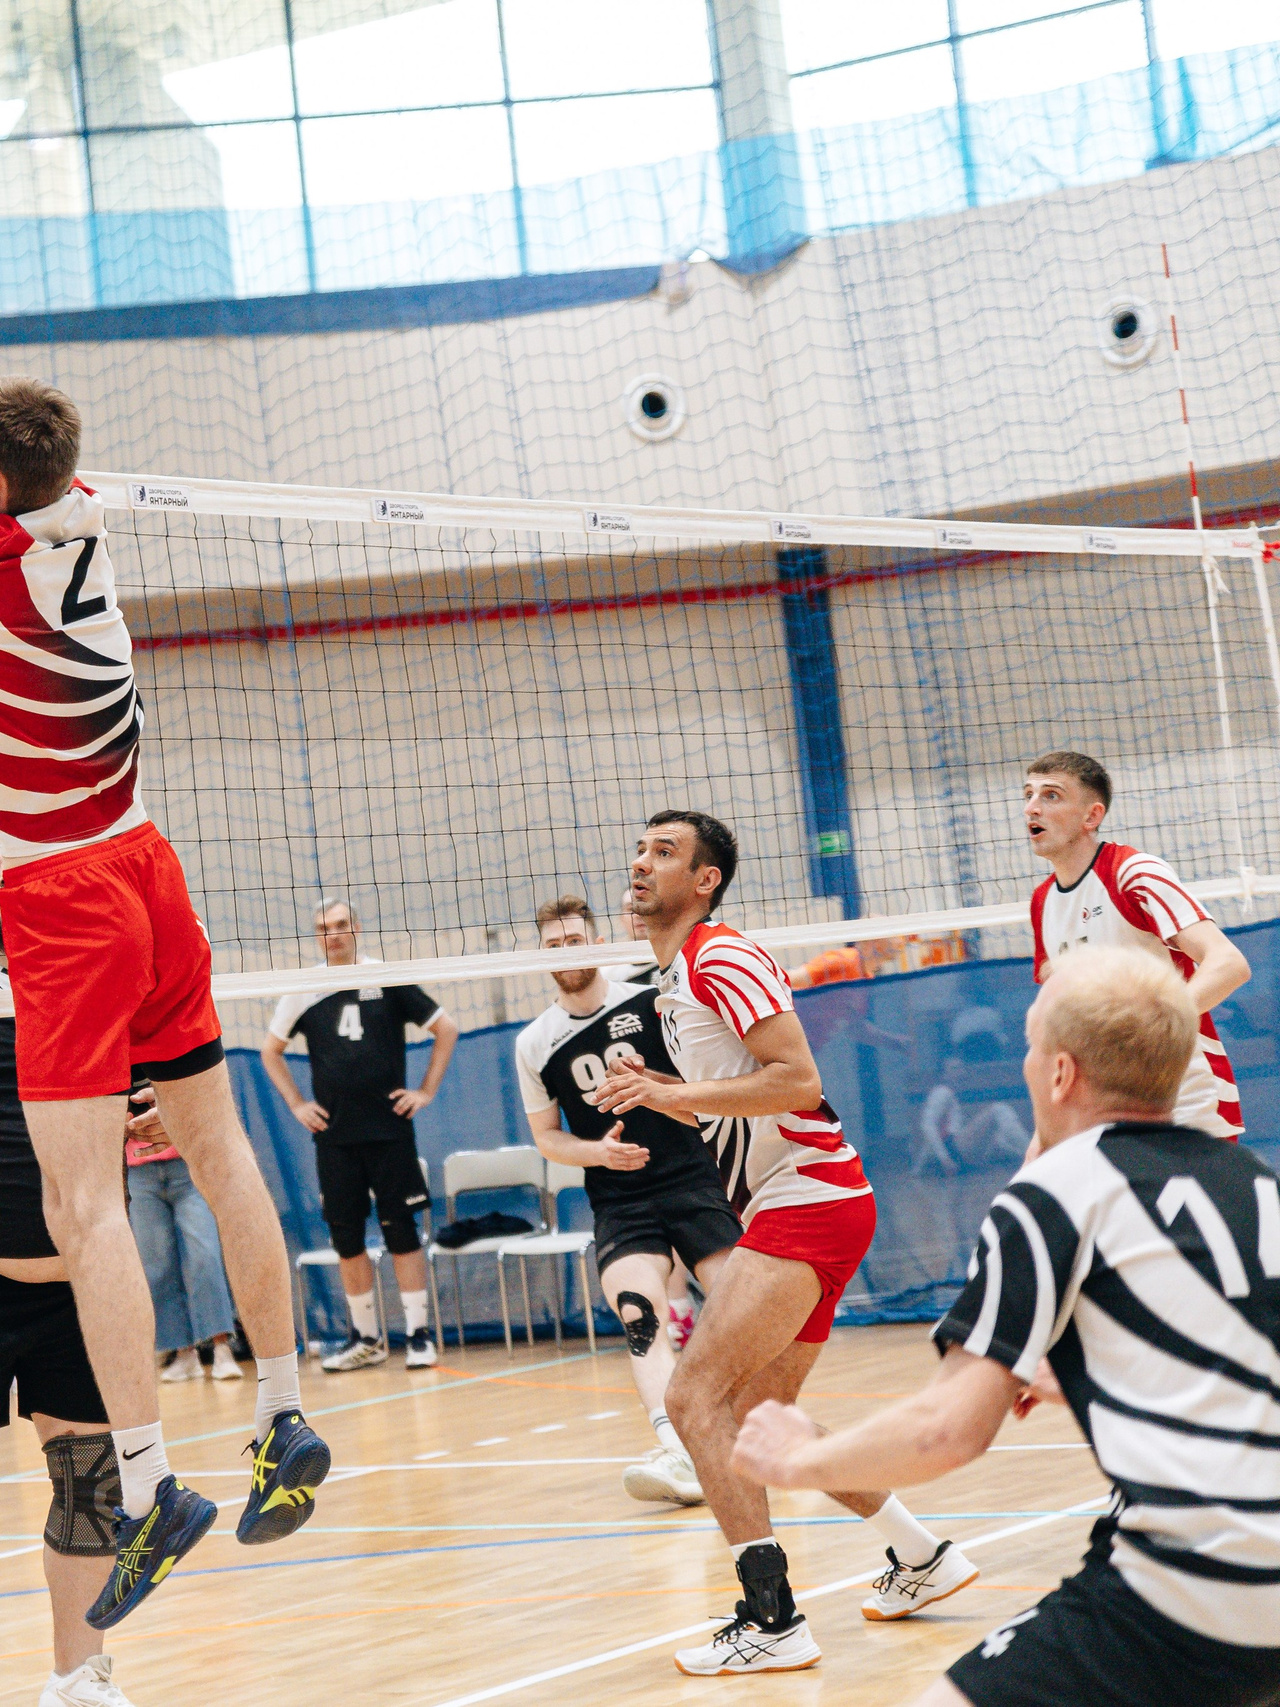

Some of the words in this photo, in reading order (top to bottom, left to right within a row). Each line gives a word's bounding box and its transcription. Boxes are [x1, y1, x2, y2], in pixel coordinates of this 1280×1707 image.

[150, 496, 188, 506] ЯНТАРНЫЙ
[338, 1004, 364, 1041] 4
[609, 1024, 643, 1040] ZENIT
